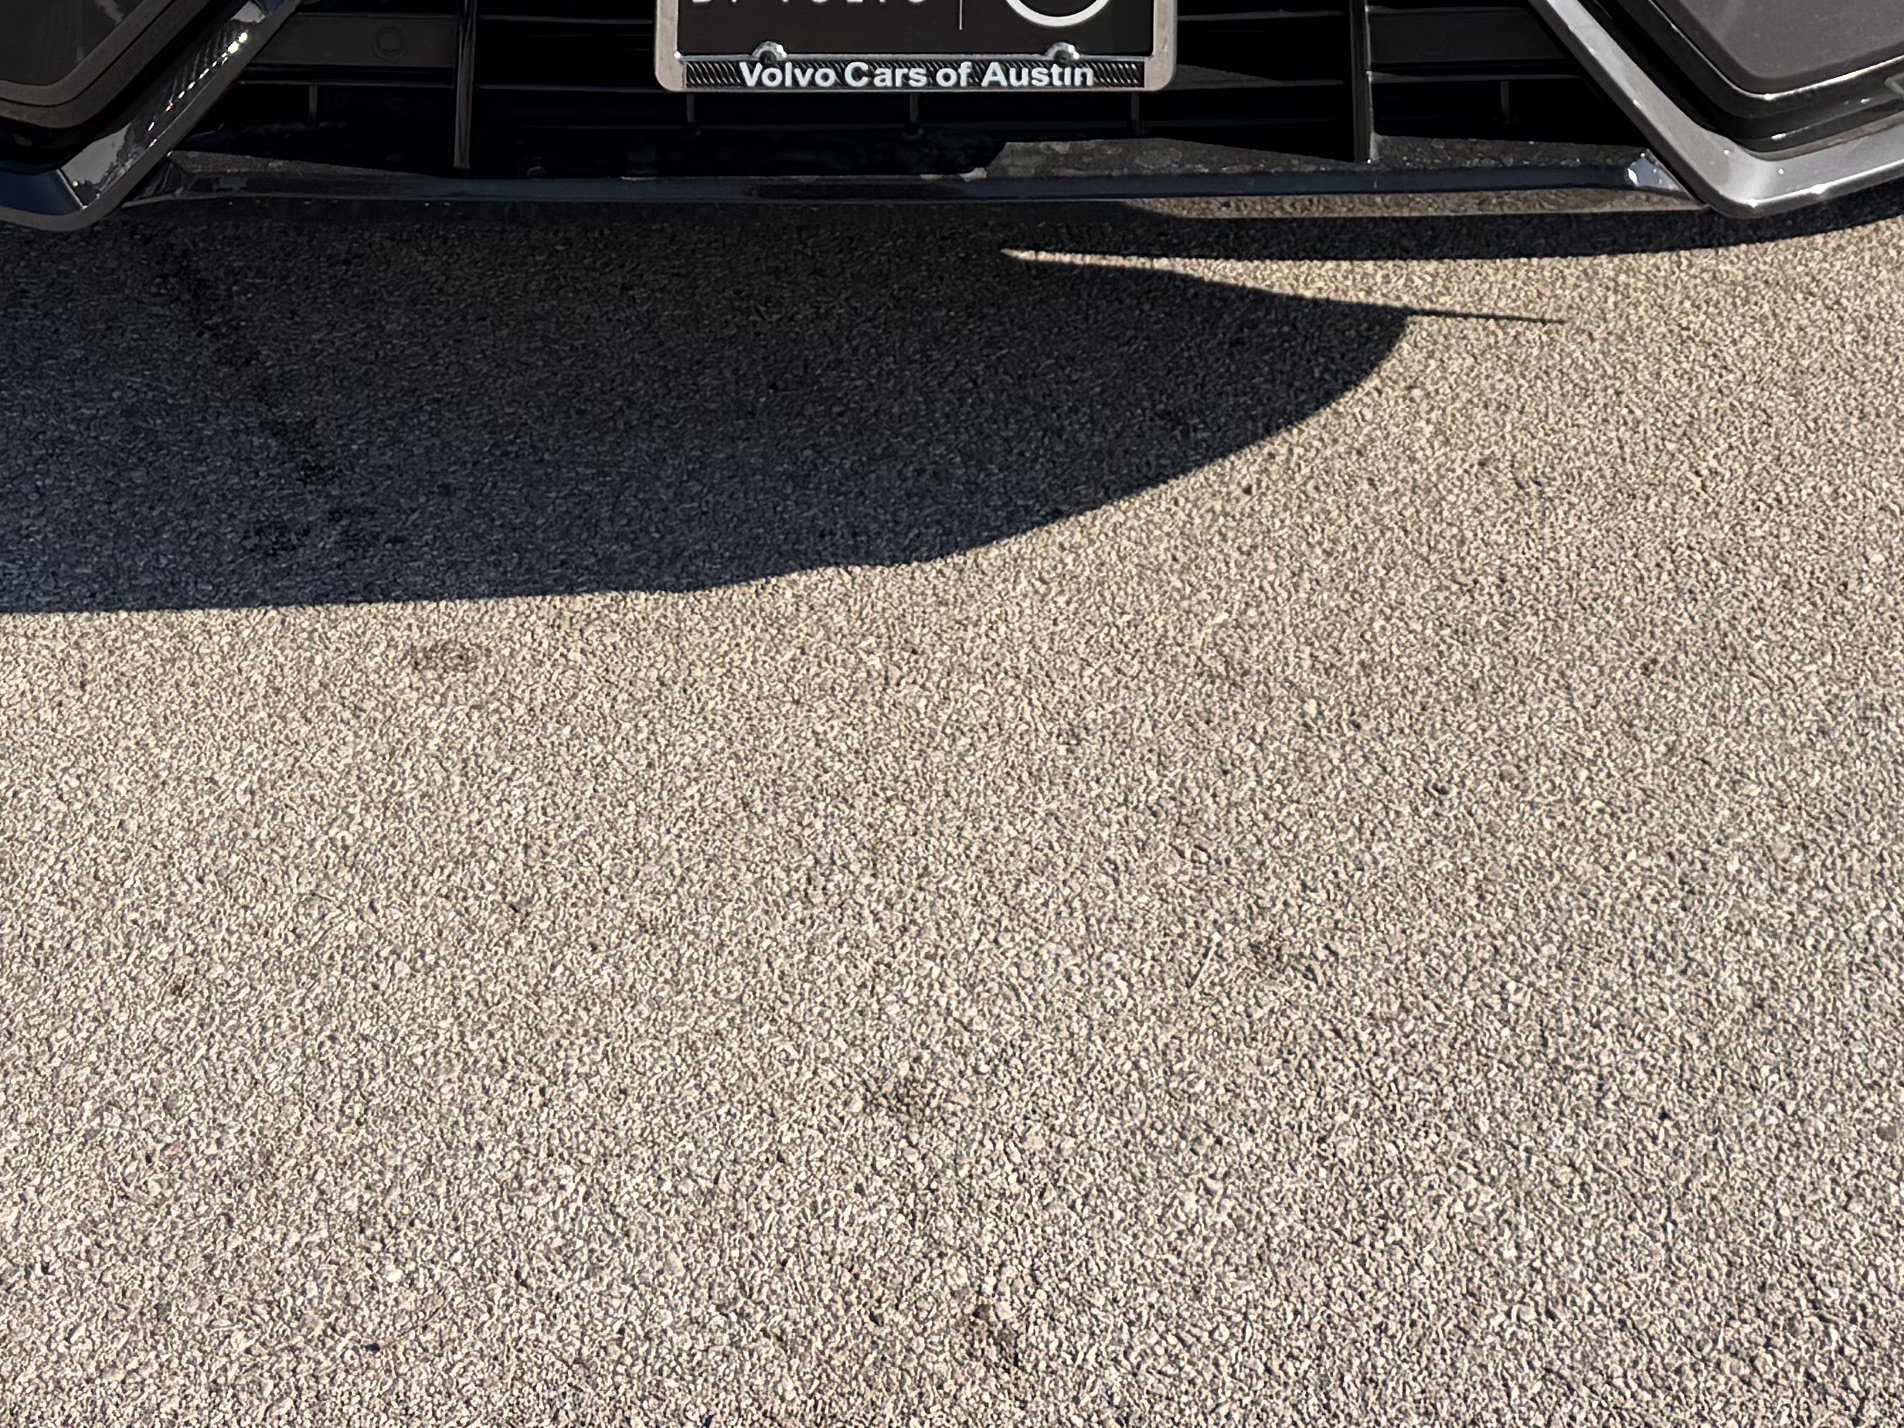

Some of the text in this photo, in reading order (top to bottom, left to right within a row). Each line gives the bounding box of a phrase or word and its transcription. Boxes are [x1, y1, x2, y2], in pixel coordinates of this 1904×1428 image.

[739, 61, 1094, 88] Volvo Cars of Austin
